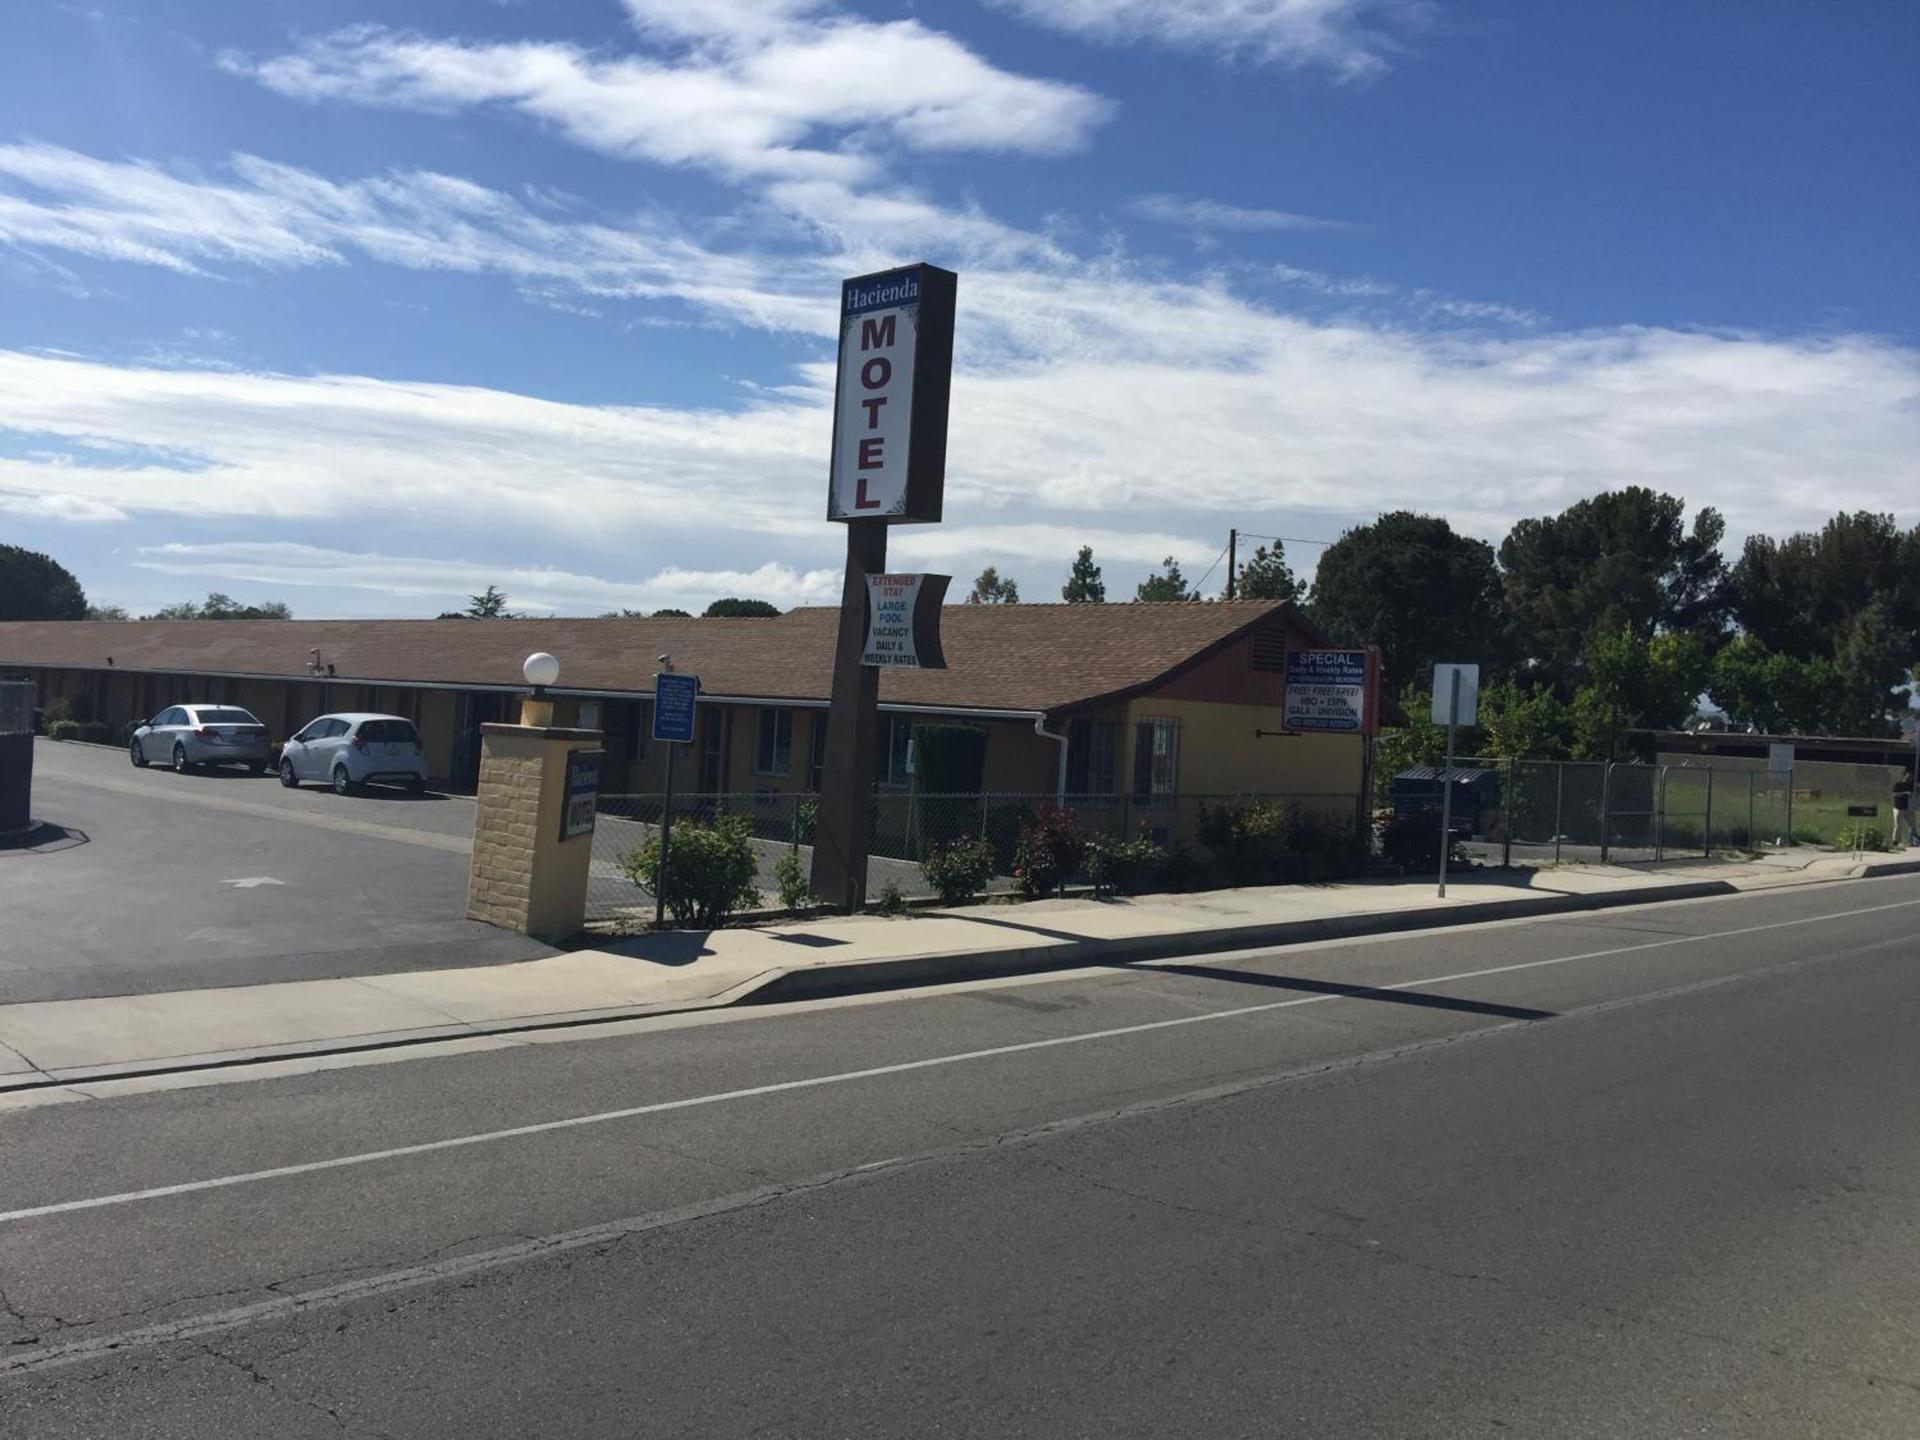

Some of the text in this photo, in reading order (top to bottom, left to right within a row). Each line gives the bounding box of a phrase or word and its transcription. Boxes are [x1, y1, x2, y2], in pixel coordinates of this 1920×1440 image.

[847, 277, 918, 309] Hacienda
[855, 315, 896, 510] MOTEL
[872, 576, 916, 586] EXTENDED
[883, 587, 904, 597] STAY
[877, 601, 907, 611] LARGE
[880, 613, 904, 623] POOL
[872, 627, 910, 637] VACANCY
[876, 641, 896, 651] DAILY
[864, 653, 892, 664] WEEKLY
[1300, 653, 1354, 665] SPECIAL
